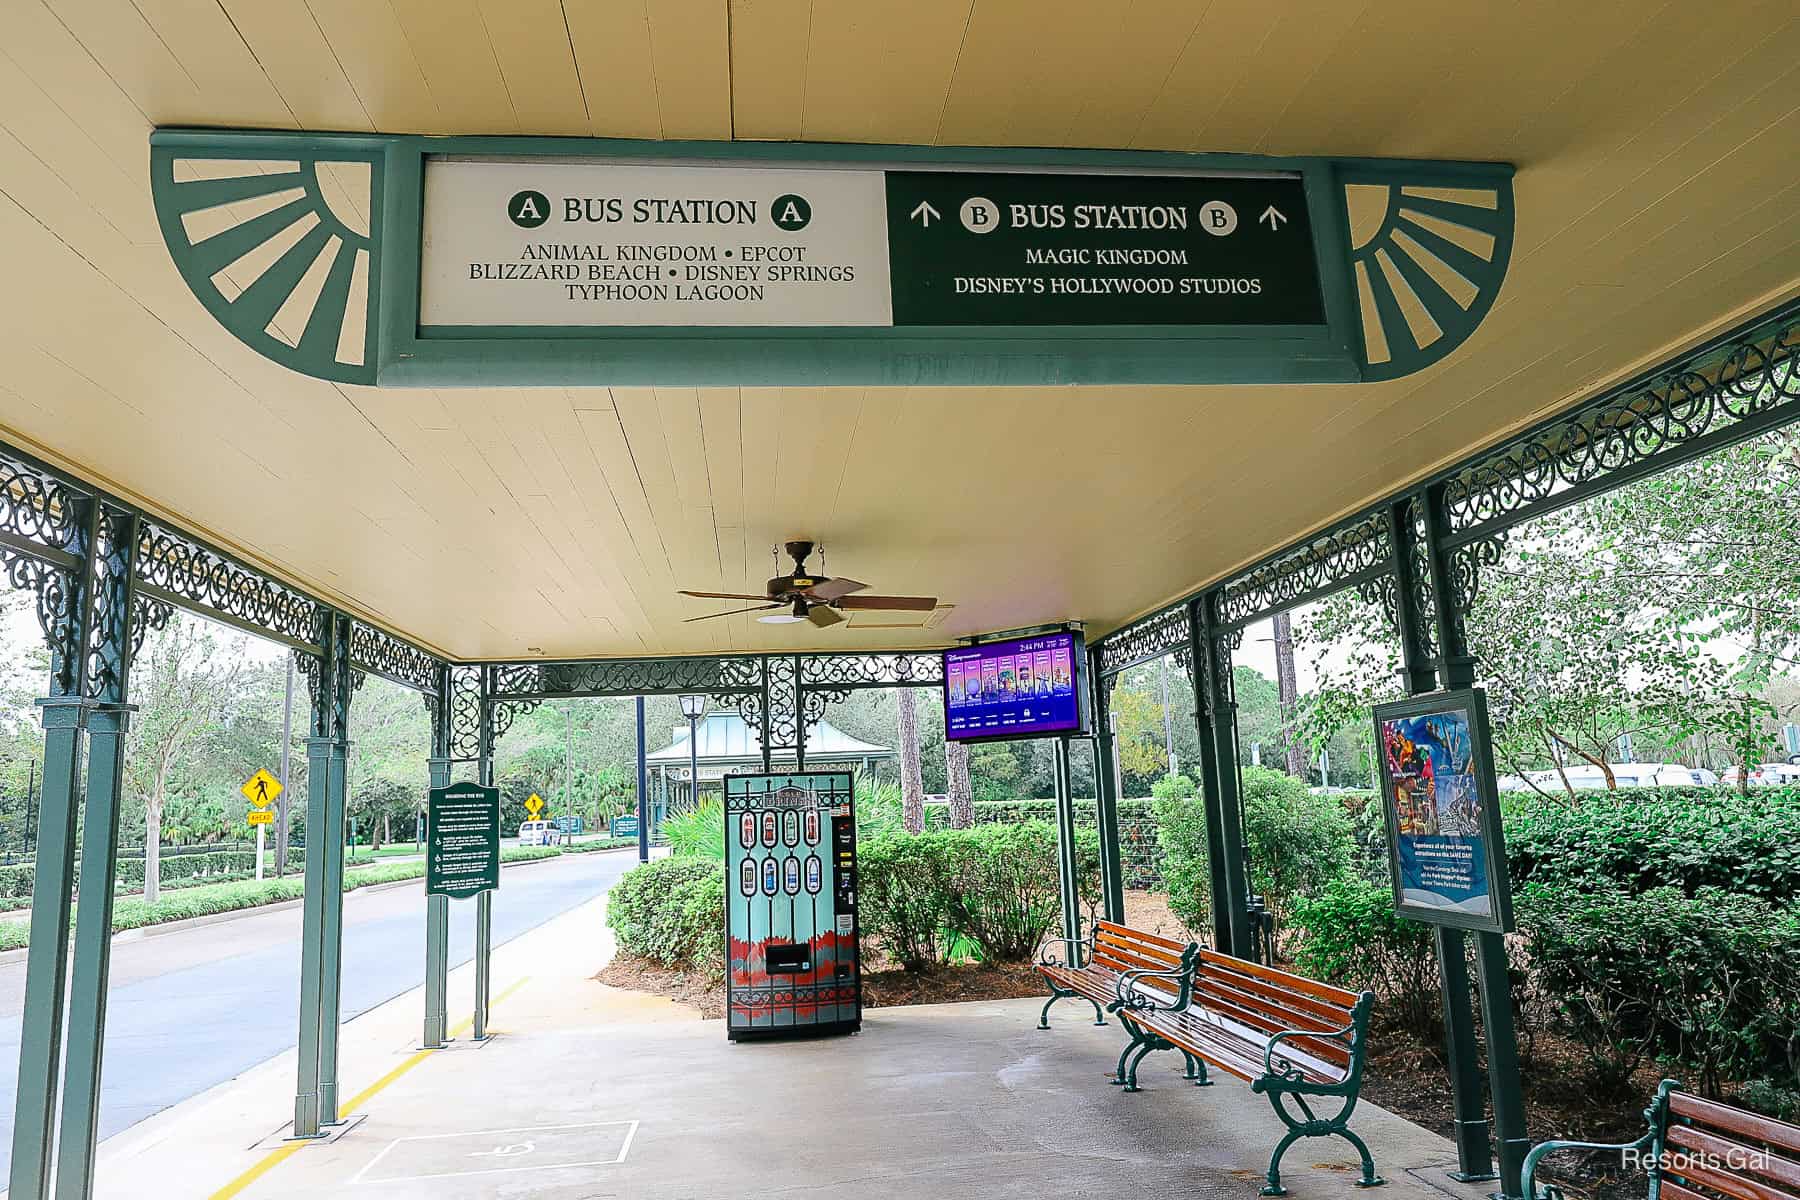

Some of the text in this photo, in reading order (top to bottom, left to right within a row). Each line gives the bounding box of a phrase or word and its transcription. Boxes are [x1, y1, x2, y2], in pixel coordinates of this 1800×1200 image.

[517, 197, 804, 225] A BUS STATION A
[1009, 204, 1066, 229] BUS
[1073, 205, 1187, 230] STATION
[519, 244, 807, 262] ANIMAL KINGDOM EPCOT
[1025, 248, 1189, 265] MAGIC KINGDOM
[469, 263, 855, 282] BLIZZARD BEACH DISNEY SPRINGS
[564, 284, 764, 301] TYPHOON LAGOON
[953, 277, 1262, 294] DISNEY'S HOLLYWOOD STUDIOS
